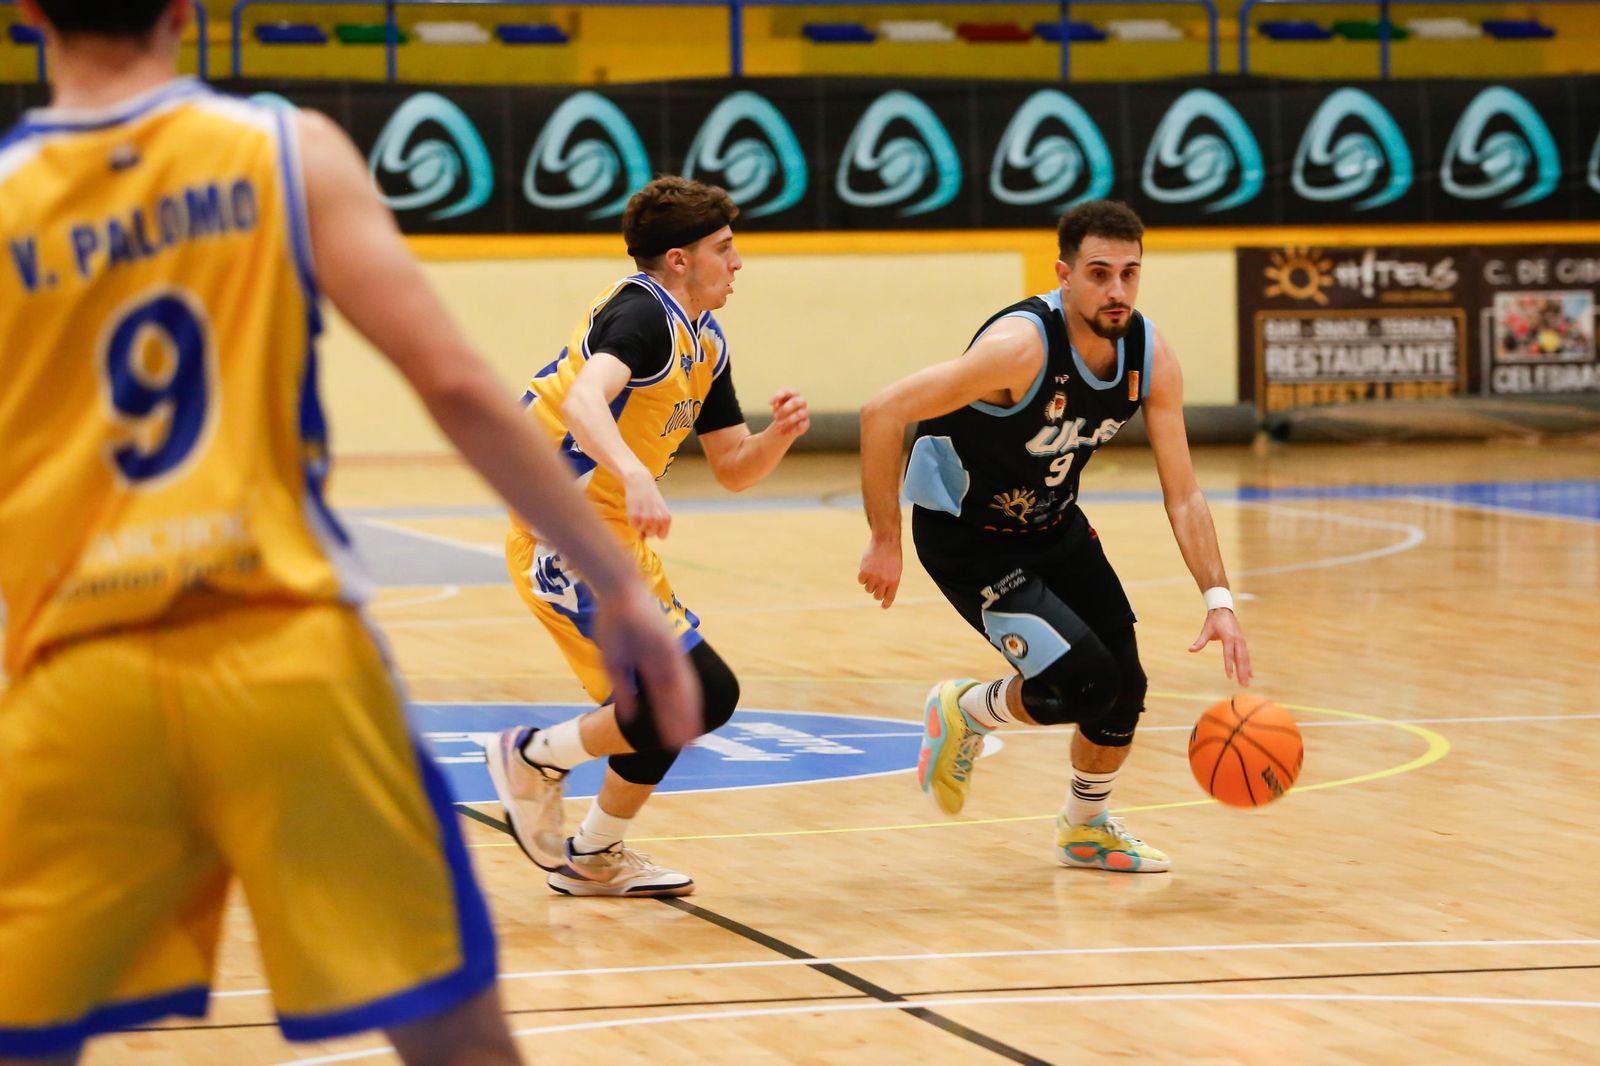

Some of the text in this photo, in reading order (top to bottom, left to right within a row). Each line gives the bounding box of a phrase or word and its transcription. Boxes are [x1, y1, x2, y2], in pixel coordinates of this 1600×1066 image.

[10, 179, 257, 293] V. PALOMO
[1517, 258, 1551, 285] DE
[1556, 257, 1600, 284] GIB
[1265, 344, 1457, 378] RESTAURANTE
[100, 286, 216, 489] 9
[1045, 452, 1075, 487] 9
